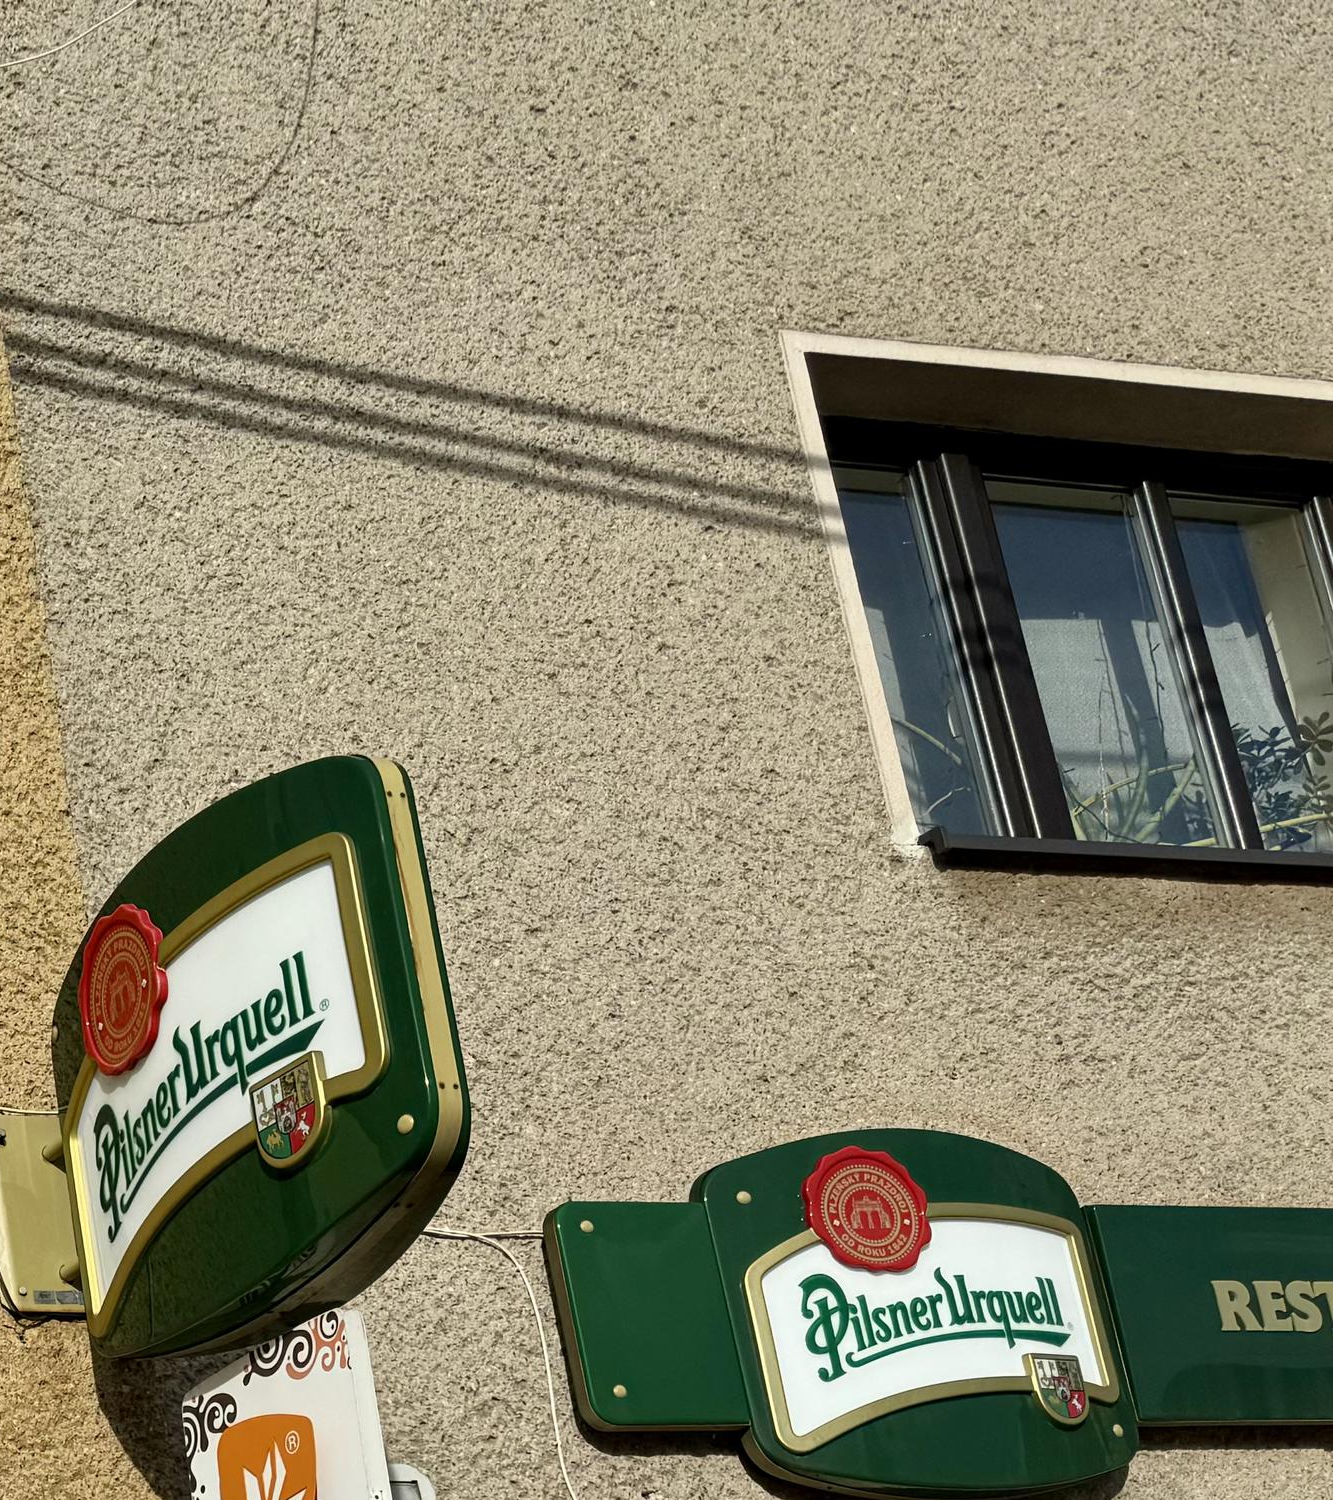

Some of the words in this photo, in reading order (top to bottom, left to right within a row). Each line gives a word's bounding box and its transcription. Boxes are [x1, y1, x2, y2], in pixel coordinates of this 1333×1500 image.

[93, 1064, 180, 1243] Pilsner
[173, 951, 316, 1105] Urquell
[864, 1172, 909, 1213] PRAZDROJ
[841, 1233, 855, 1247] OD
[857, 1243, 886, 1256] ROKU
[798, 1273, 943, 1382] Pilsner
[933, 1266, 1065, 1349] Urquell
